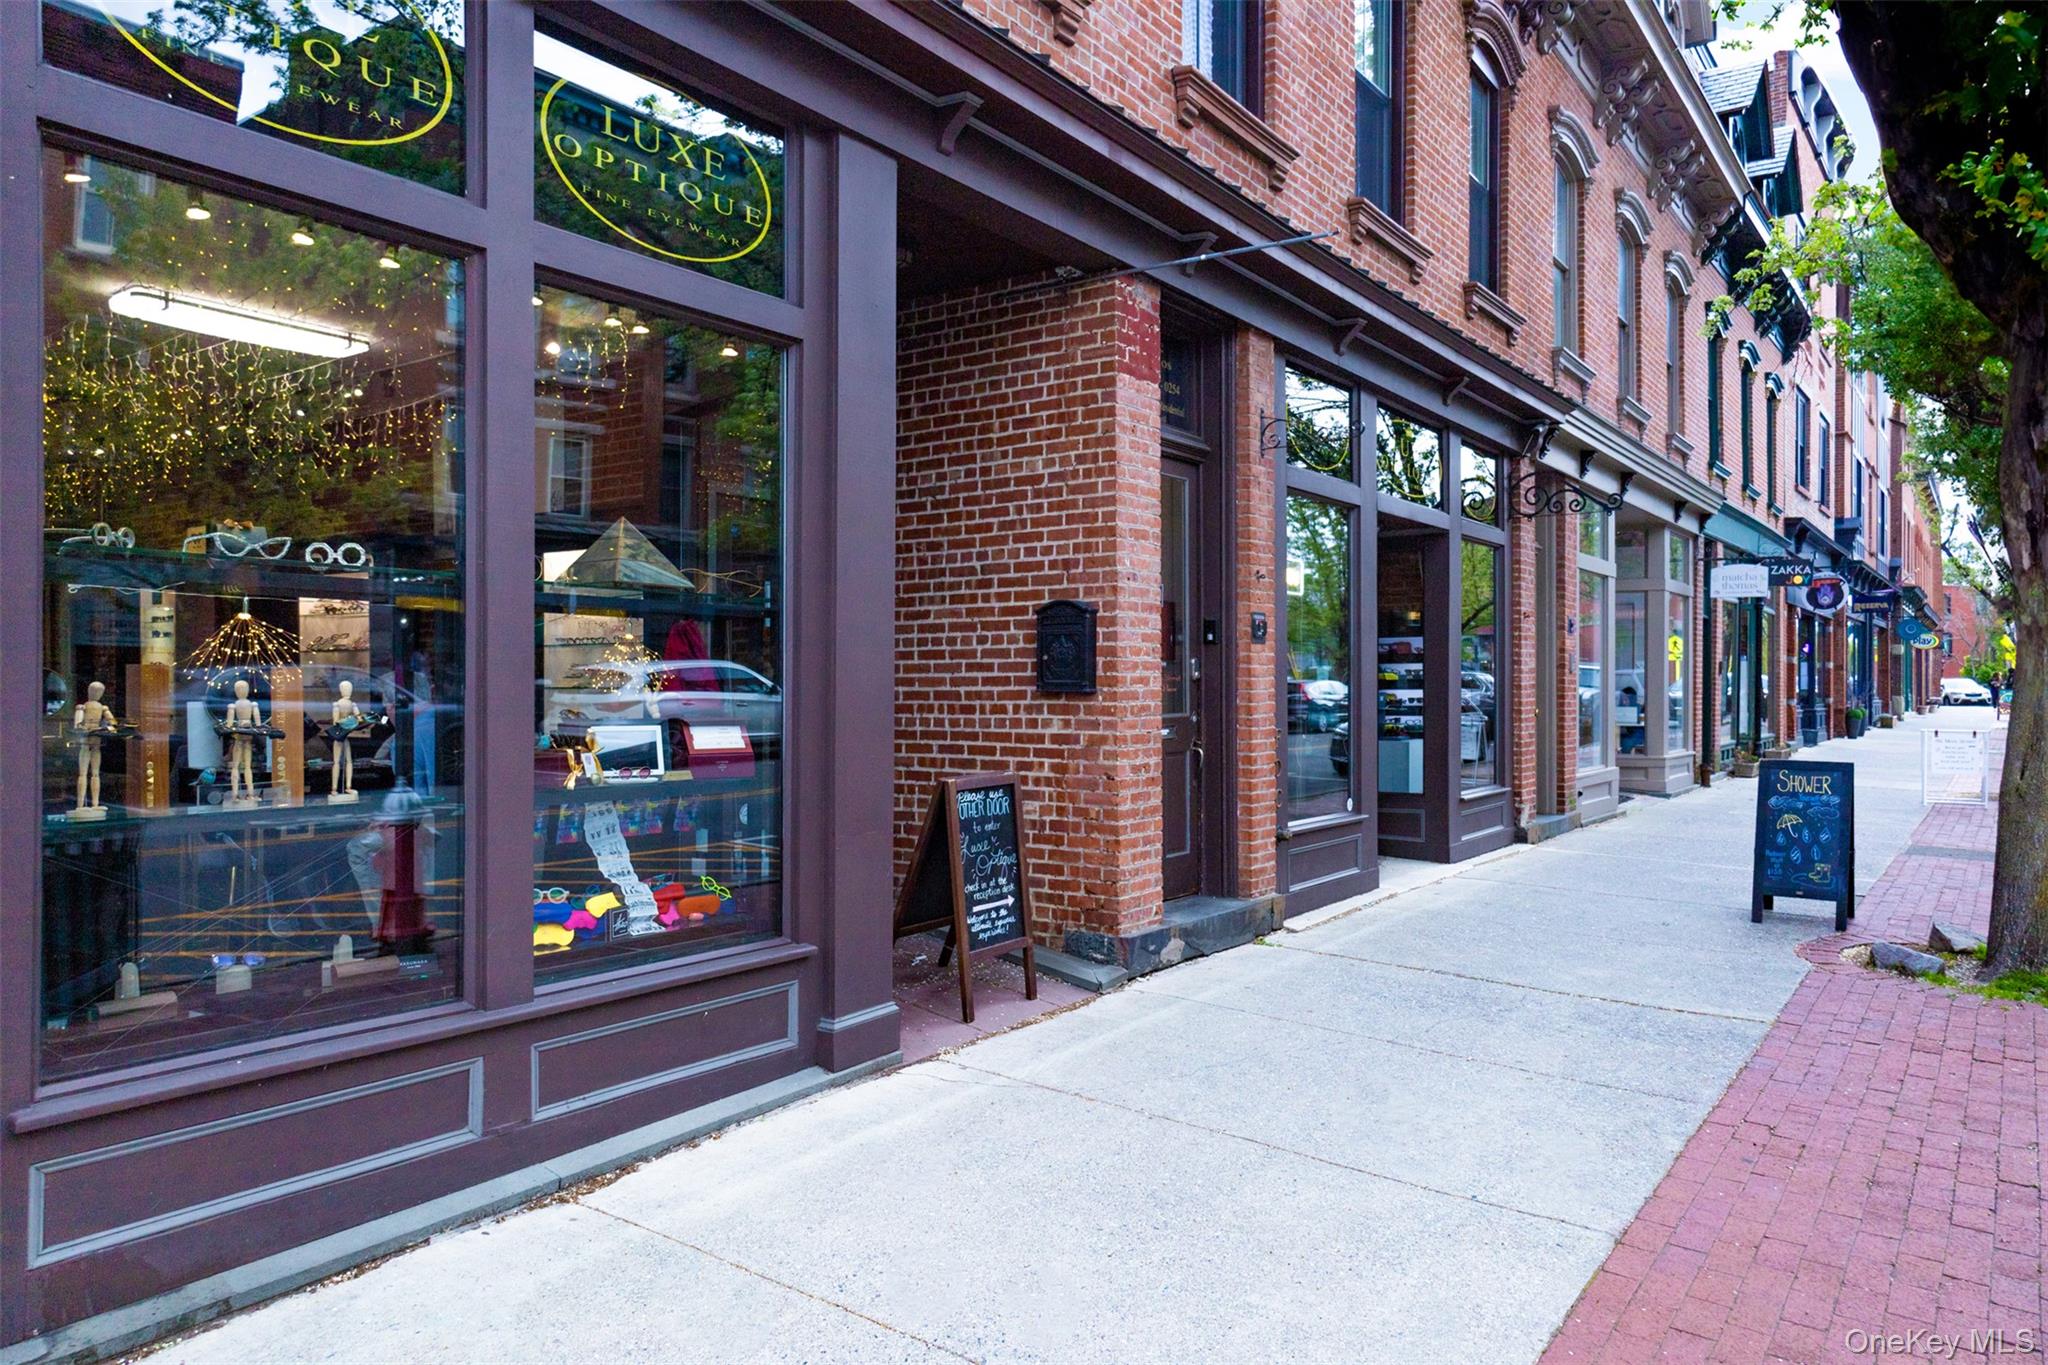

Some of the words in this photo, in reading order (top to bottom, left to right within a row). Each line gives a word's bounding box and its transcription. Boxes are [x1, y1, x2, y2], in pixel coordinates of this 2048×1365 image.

[141, 27, 224, 66] FINE
[299, 84, 405, 130] EWEAR
[601, 104, 727, 182] LUXE
[553, 133, 763, 228] OPTIQUE
[582, 184, 632, 210] FINE
[647, 207, 741, 248] EYEWEAR
[1770, 564, 1812, 575] ZAKKA
[1786, 575, 1811, 585] JOY
[1776, 769, 1832, 795] SHOWER
[958, 800, 985, 820] OTHER
[986, 796, 1010, 817] DOOR
[972, 821, 982, 834] to
